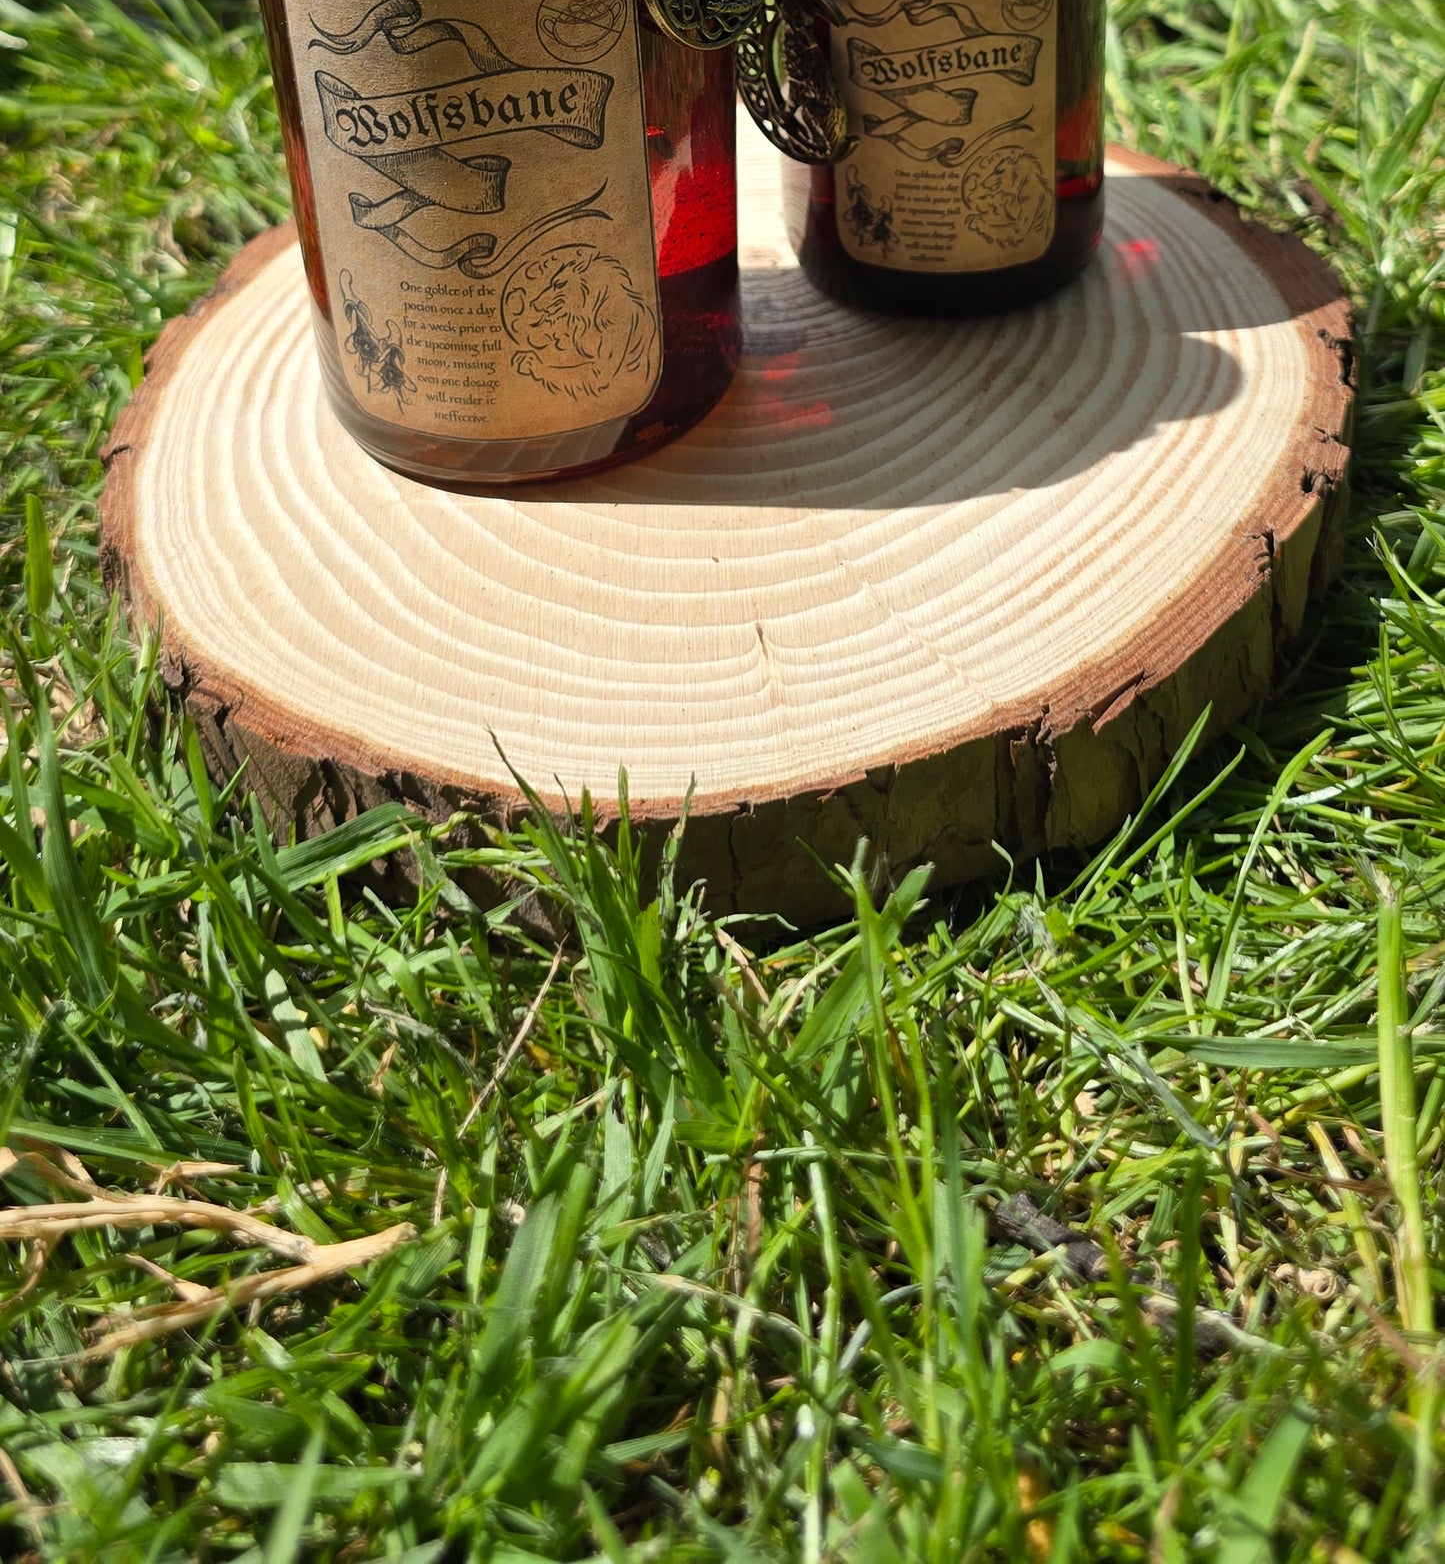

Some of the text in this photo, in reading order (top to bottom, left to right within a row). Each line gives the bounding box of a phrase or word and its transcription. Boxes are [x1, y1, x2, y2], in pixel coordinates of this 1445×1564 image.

[860, 43, 1023, 86] Wolfsbane
[335, 81, 579, 148] Wolfsbane
[400, 281, 497, 300] One goblet of the
[403, 302, 438, 314] potion
[440, 306, 465, 315] once
[476, 304, 496, 318] day
[402, 316, 418, 329] for
[427, 321, 457, 333] week
[458, 324, 487, 337] prior
[406, 335, 502, 356] the upcoming full
[452, 359, 497, 375] missing
[417, 374, 501, 393] even one dosage
[425, 391, 497, 405] will render it
